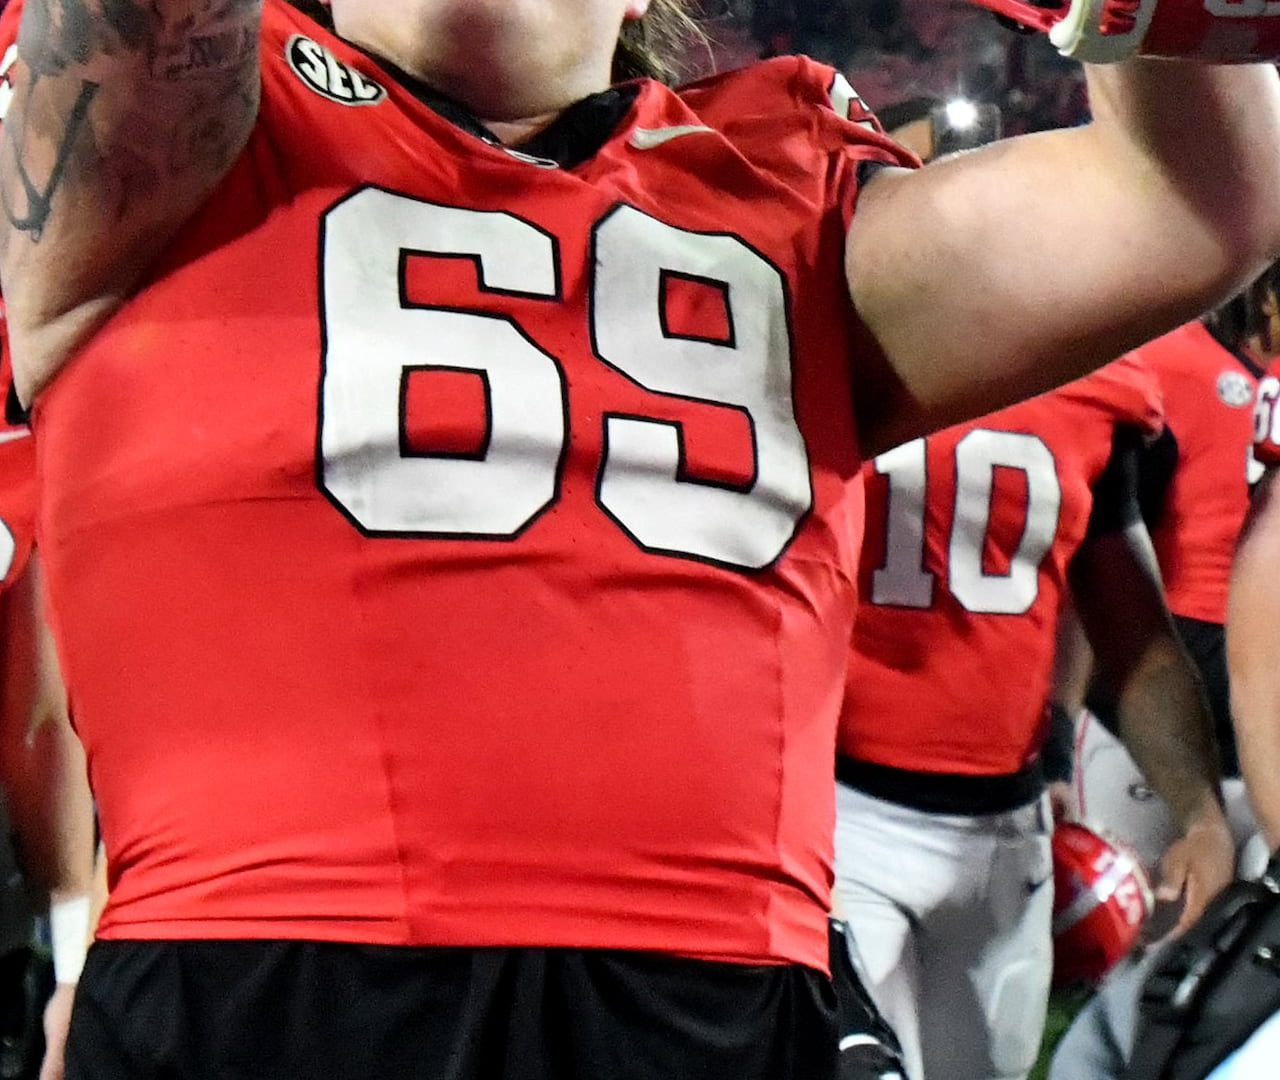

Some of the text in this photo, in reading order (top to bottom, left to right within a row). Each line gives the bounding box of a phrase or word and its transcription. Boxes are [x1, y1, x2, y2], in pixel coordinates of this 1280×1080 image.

[288, 37, 383, 103] SEC
[317, 183, 814, 573] 69
[871, 428, 1061, 615] 10
